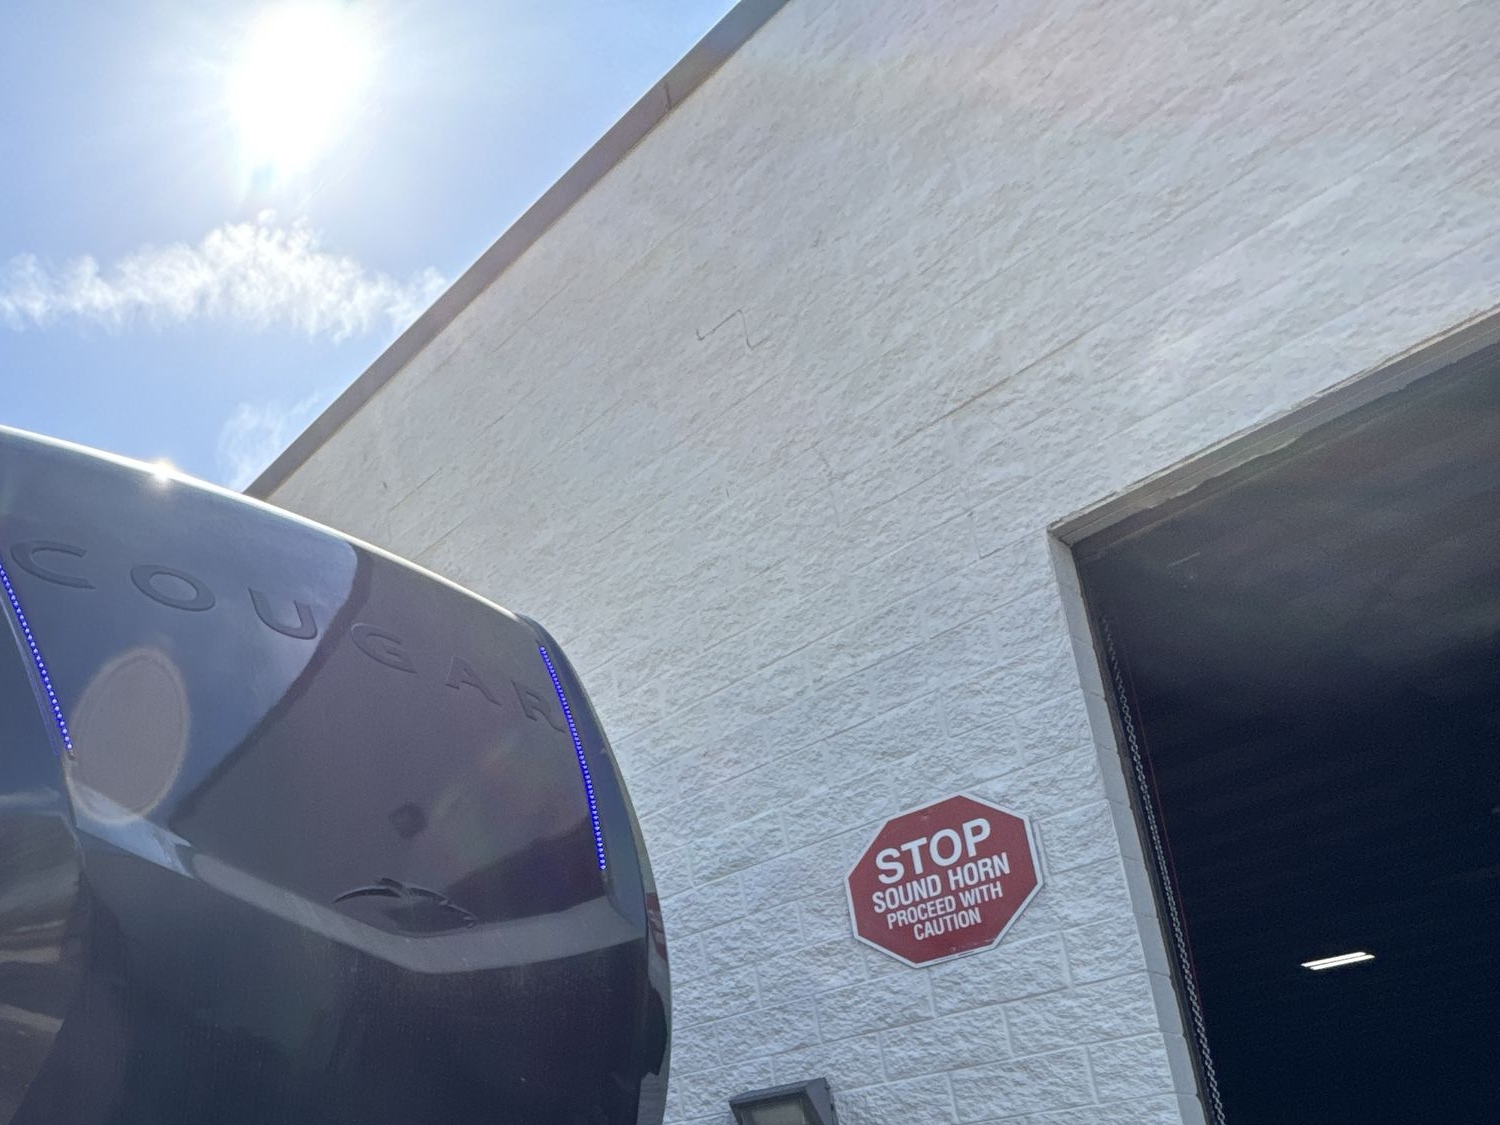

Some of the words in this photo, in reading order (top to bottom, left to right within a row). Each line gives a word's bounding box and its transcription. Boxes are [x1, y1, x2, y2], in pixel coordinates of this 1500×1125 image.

[10, 540, 568, 732] COUGAR
[875, 818, 991, 884] STOP
[872, 874, 942, 913] SOUND
[948, 852, 1010, 890] HORN
[887, 895, 956, 929] PROCEED
[959, 881, 1003, 908] WITH
[913, 907, 982, 940] CAUTION
